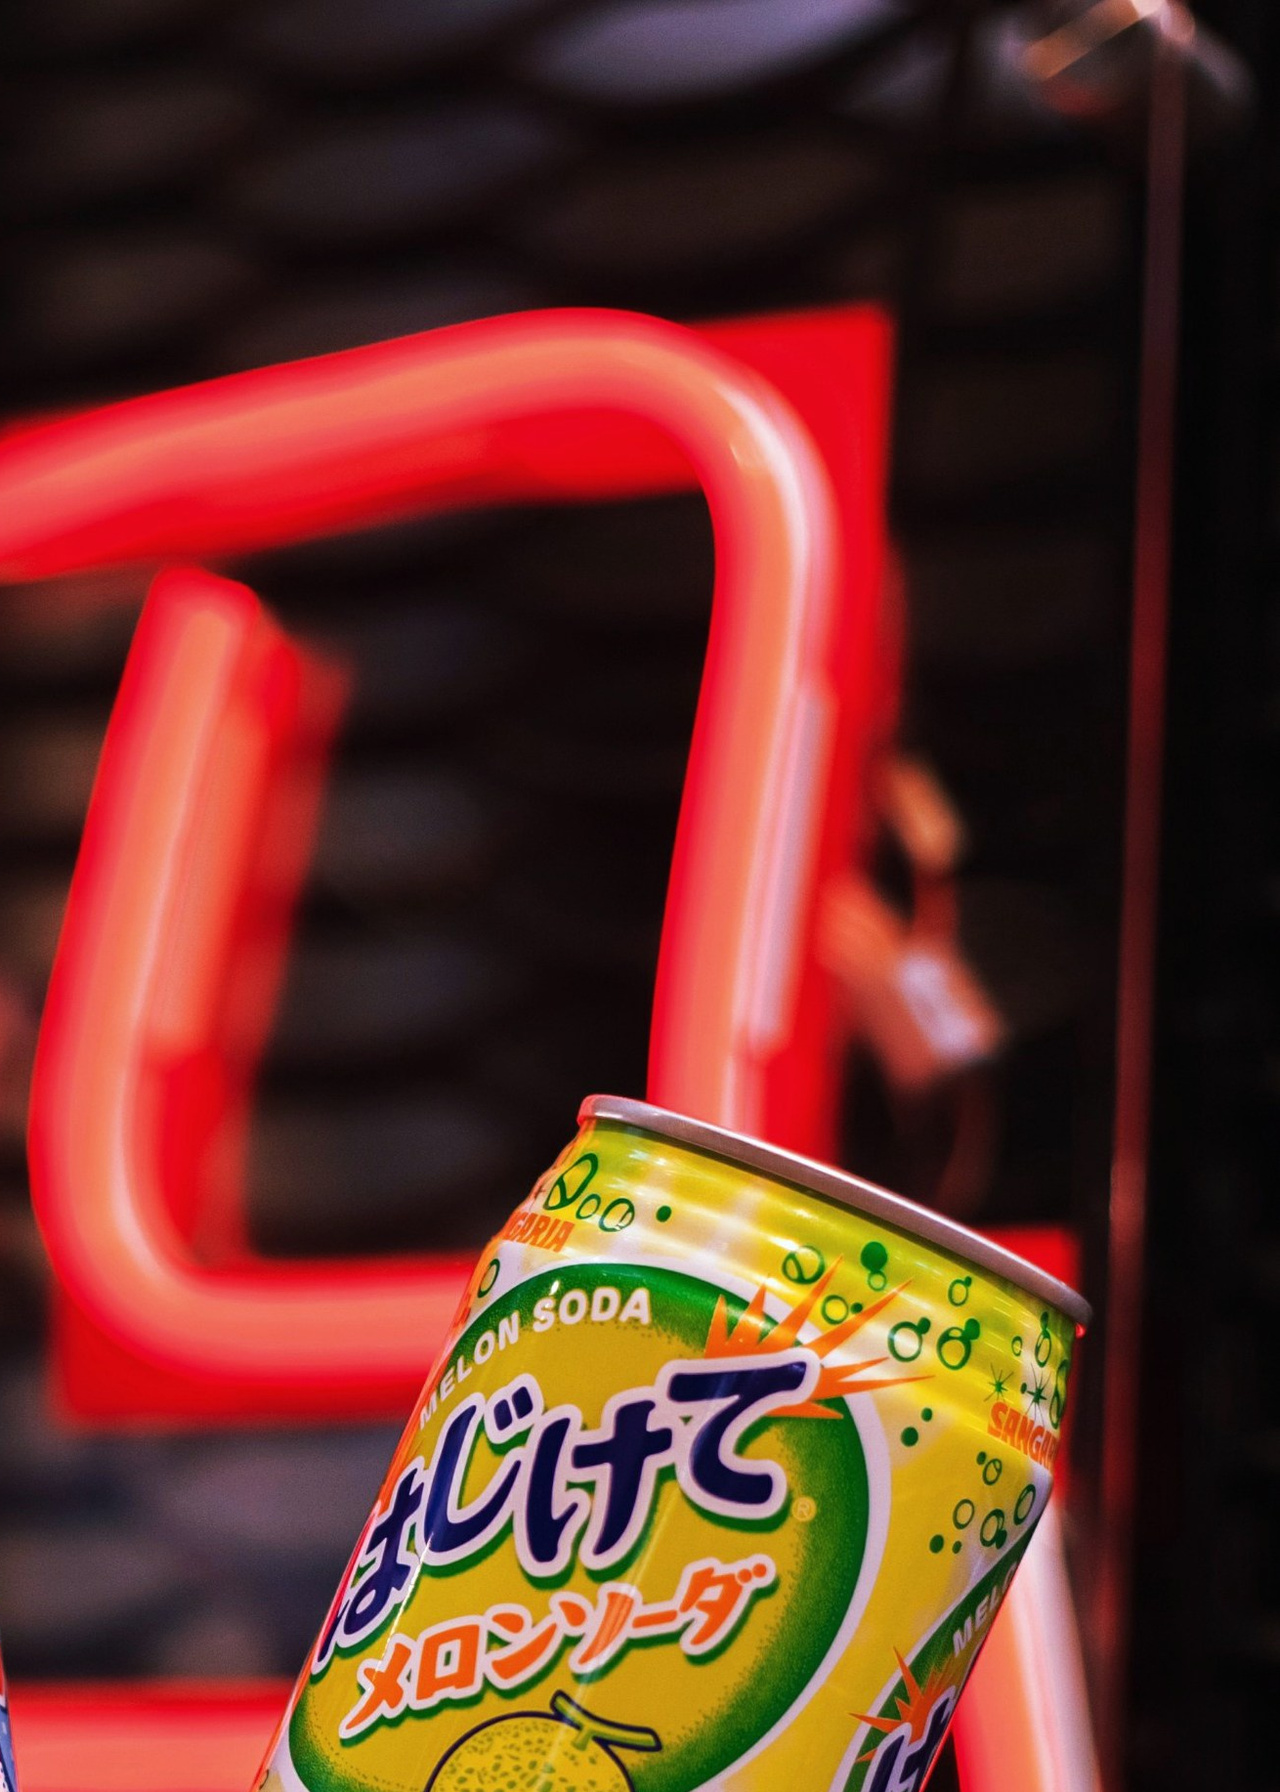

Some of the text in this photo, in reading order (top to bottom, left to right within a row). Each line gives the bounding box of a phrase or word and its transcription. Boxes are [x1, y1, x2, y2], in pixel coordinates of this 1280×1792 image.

[503, 1211, 576, 1253] GARIA
[420, 1287, 651, 1430] MELON SODA
[314, 1356, 811, 1667] はじけて
[344, 1560, 770, 1732] メロンソーダ
